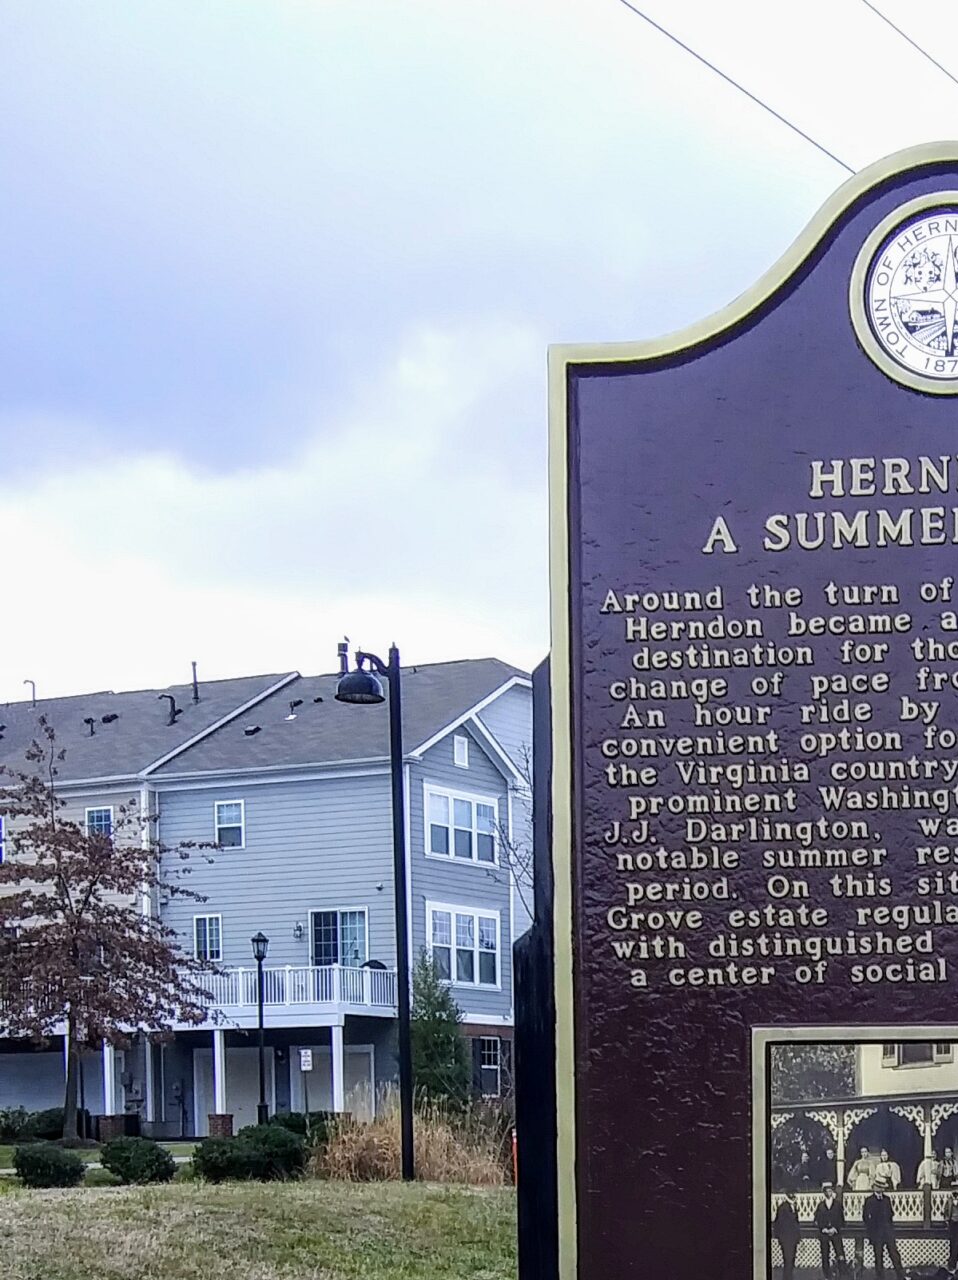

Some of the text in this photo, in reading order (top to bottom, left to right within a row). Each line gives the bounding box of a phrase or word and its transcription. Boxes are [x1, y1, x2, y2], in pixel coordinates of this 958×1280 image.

[876, 255, 894, 286] OF
[874, 298, 909, 359] TOWN
[702, 516, 737, 553] A
[600, 586, 722, 612] Around
[746, 583, 801, 607] the
[824, 581, 898, 604] turn
[920, 576, 953, 601] of
[626, 614, 763, 640] Herndon
[788, 612, 911, 635] became
[941, 611, 958, 630] a
[632, 641, 813, 669] destination
[840, 639, 888, 663] for
[609, 677, 727, 703] change
[751, 671, 783, 695] of
[810, 673, 889, 699] pace
[621, 703, 666, 727] An
[694, 703, 771, 726] hour
[800, 698, 871, 723] ride
[900, 696, 939, 724] by
[602, 729, 778, 756] convenient
[800, 726, 902, 757] option
[604, 762, 657, 785] the
[675, 758, 809, 788] Virginia
[628, 787, 796, 819] prominent
[604, 819, 657, 844] J.J.
[686, 815, 881, 847] Darlington,
[616, 845, 739, 871] notable
[762, 848, 887, 867] summer
[625, 876, 737, 906] period.
[767, 875, 810, 898] On
[829, 872, 892, 897] this
[607, 906, 703, 930] Grove
[728, 903, 828, 927] estate
[610, 935, 686, 959] with
[708, 930, 933, 960] distinguished
[630, 968, 647, 986] a
[668, 961, 775, 986] center
[795, 960, 828, 983] of
[851, 957, 947, 983] social
